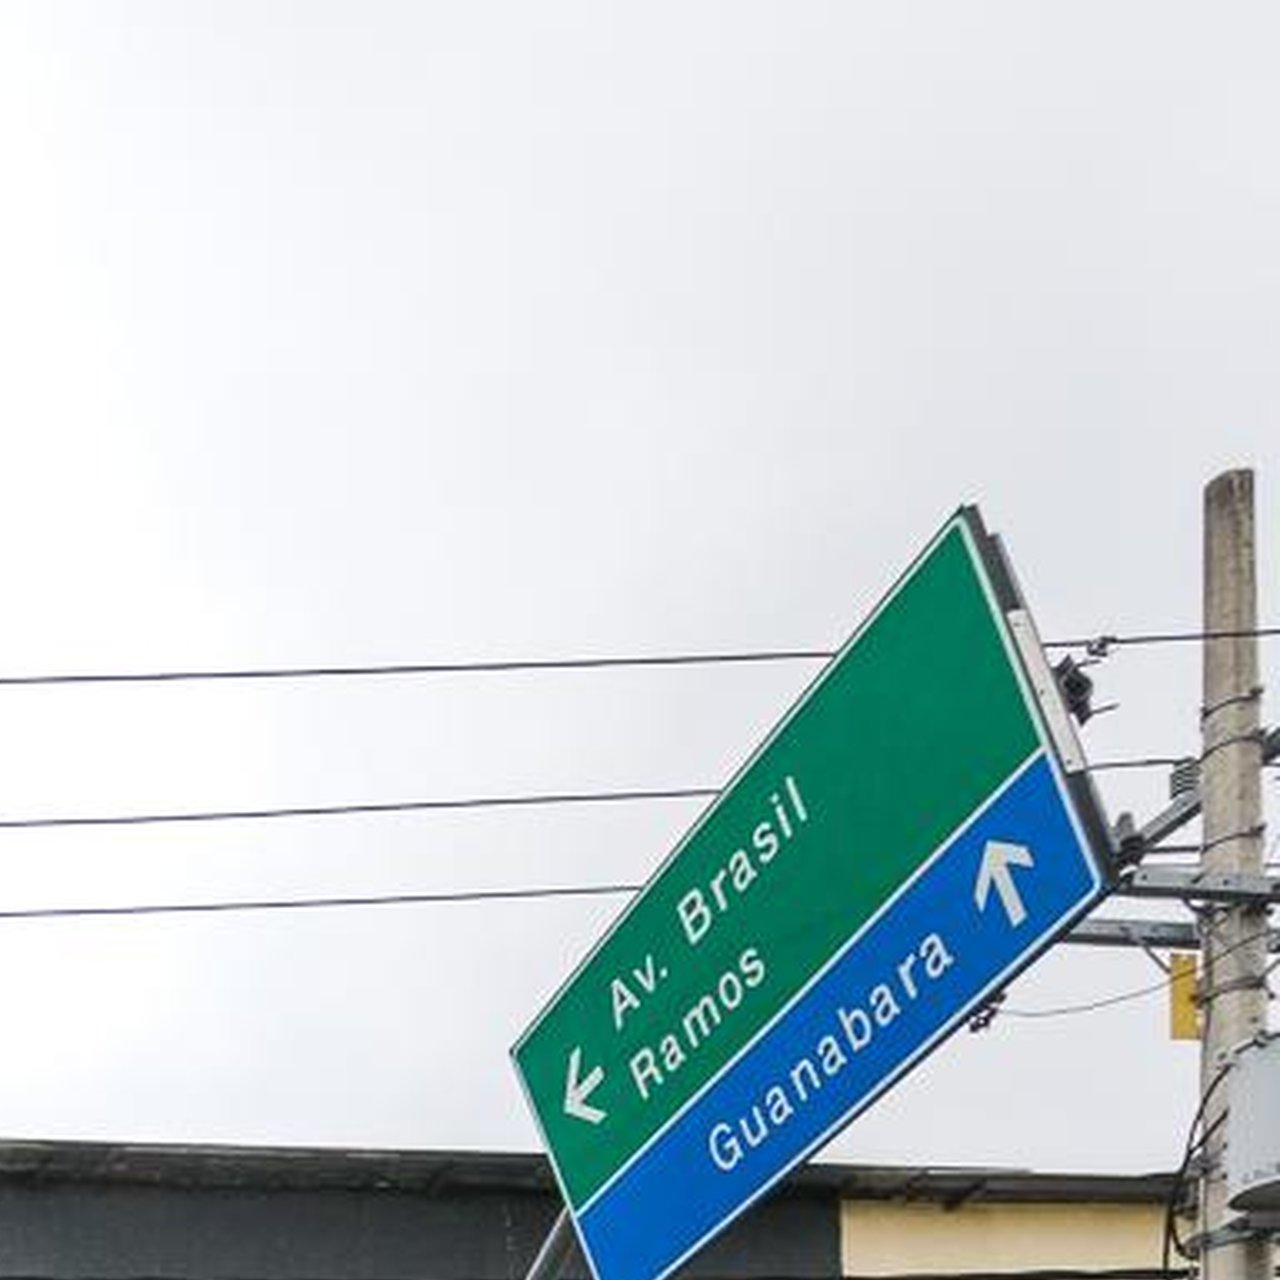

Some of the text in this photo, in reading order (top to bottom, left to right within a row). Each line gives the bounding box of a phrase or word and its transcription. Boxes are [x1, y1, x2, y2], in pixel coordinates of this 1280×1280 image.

[611, 776, 808, 1030] Av. Brasil
[628, 949, 766, 1100] Ramos
[708, 932, 954, 1171] Guanabara
